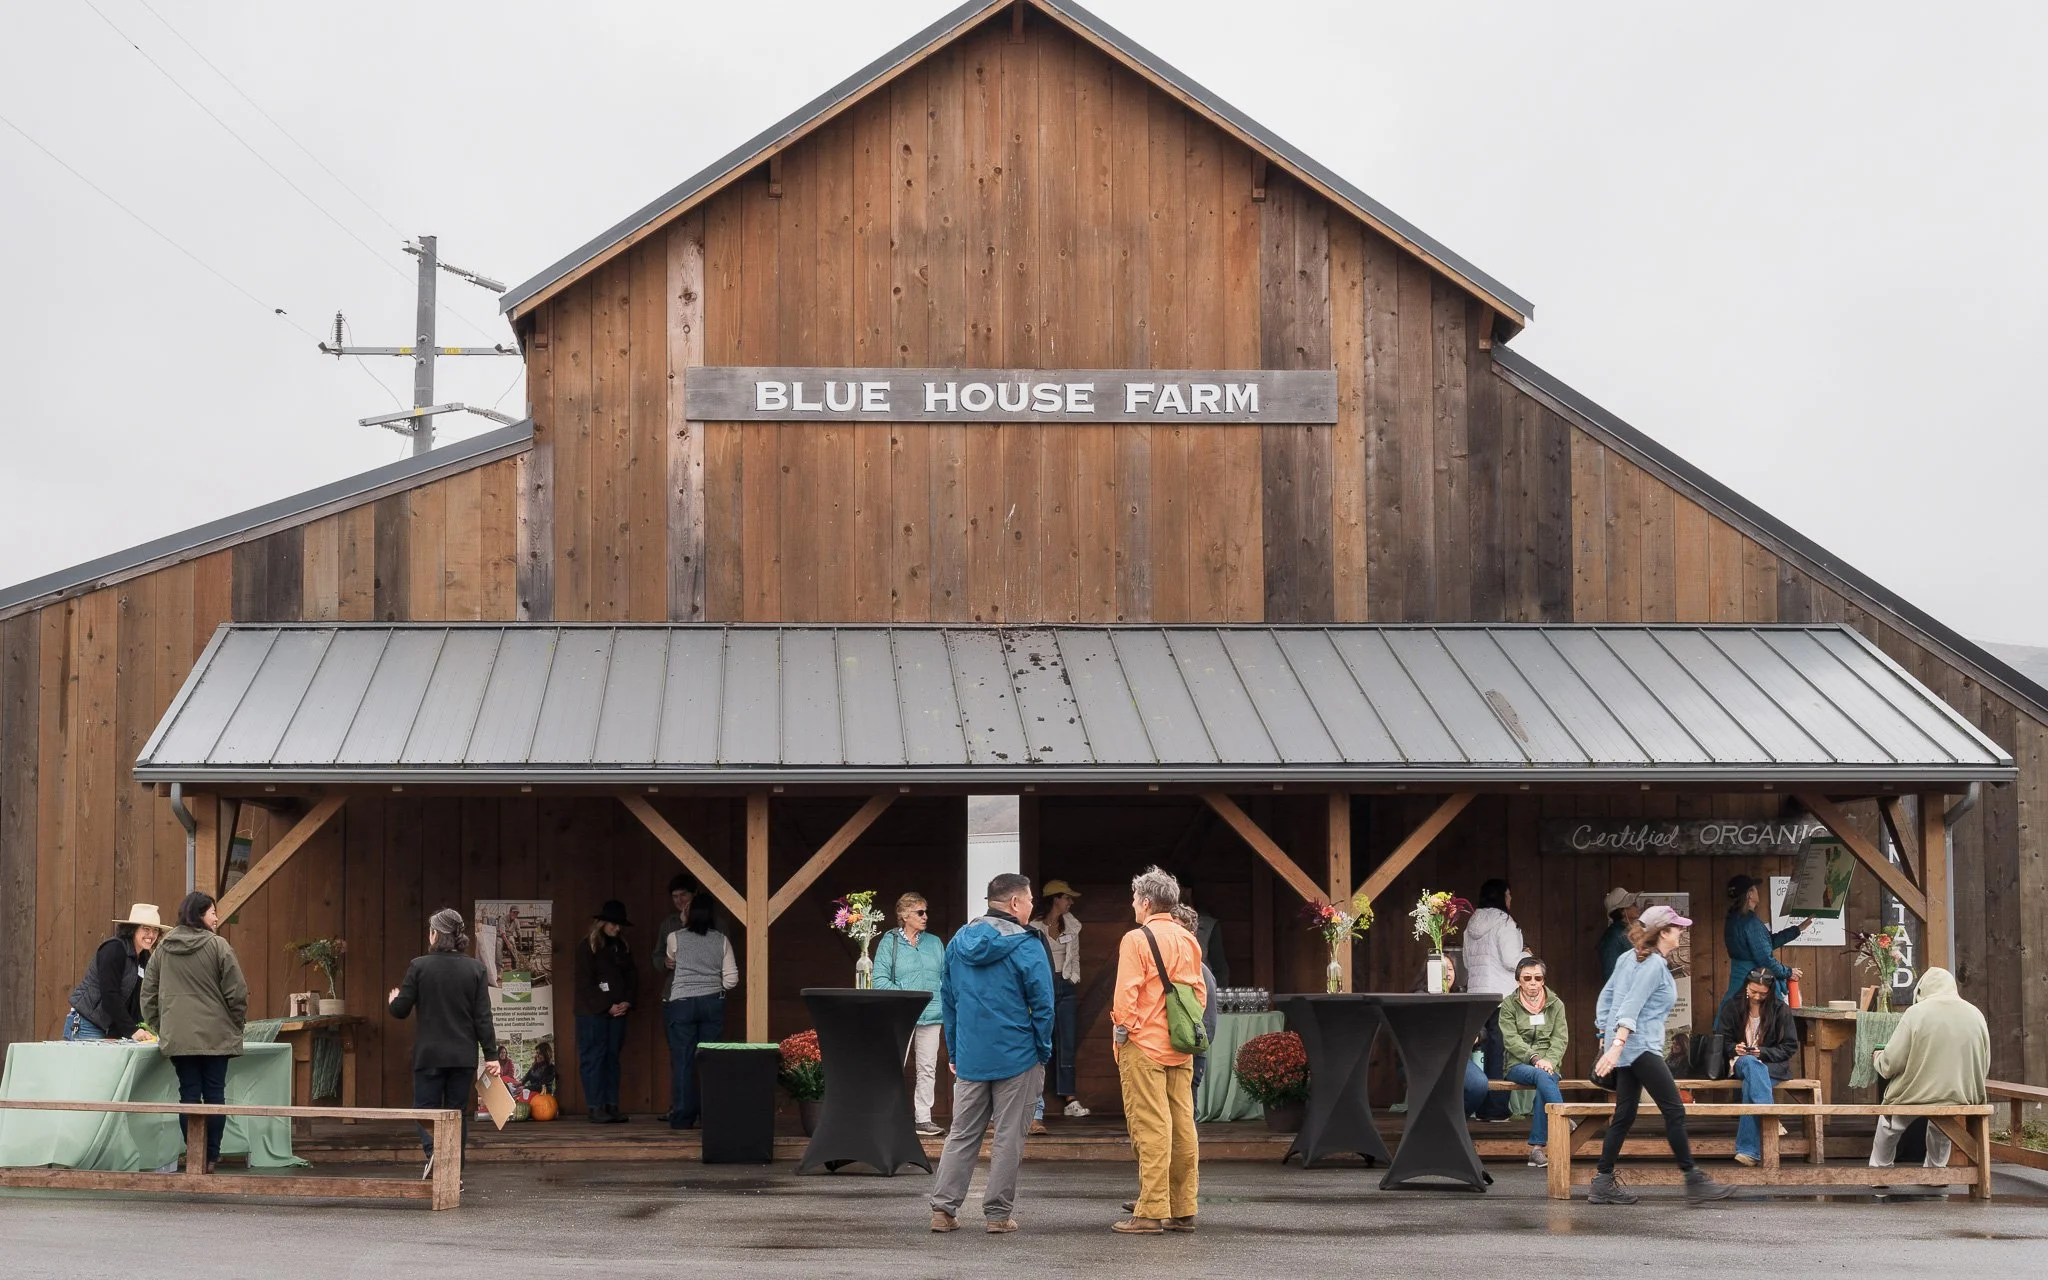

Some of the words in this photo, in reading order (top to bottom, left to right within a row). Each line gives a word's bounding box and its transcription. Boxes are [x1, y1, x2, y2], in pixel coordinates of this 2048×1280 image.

[754, 381, 891, 413] BLUE
[922, 381, 1095, 414] HOUSE
[1123, 382, 1260, 415] FARM
[1572, 824, 1680, 852] Certified
[1891, 896, 1914, 988] TAND
